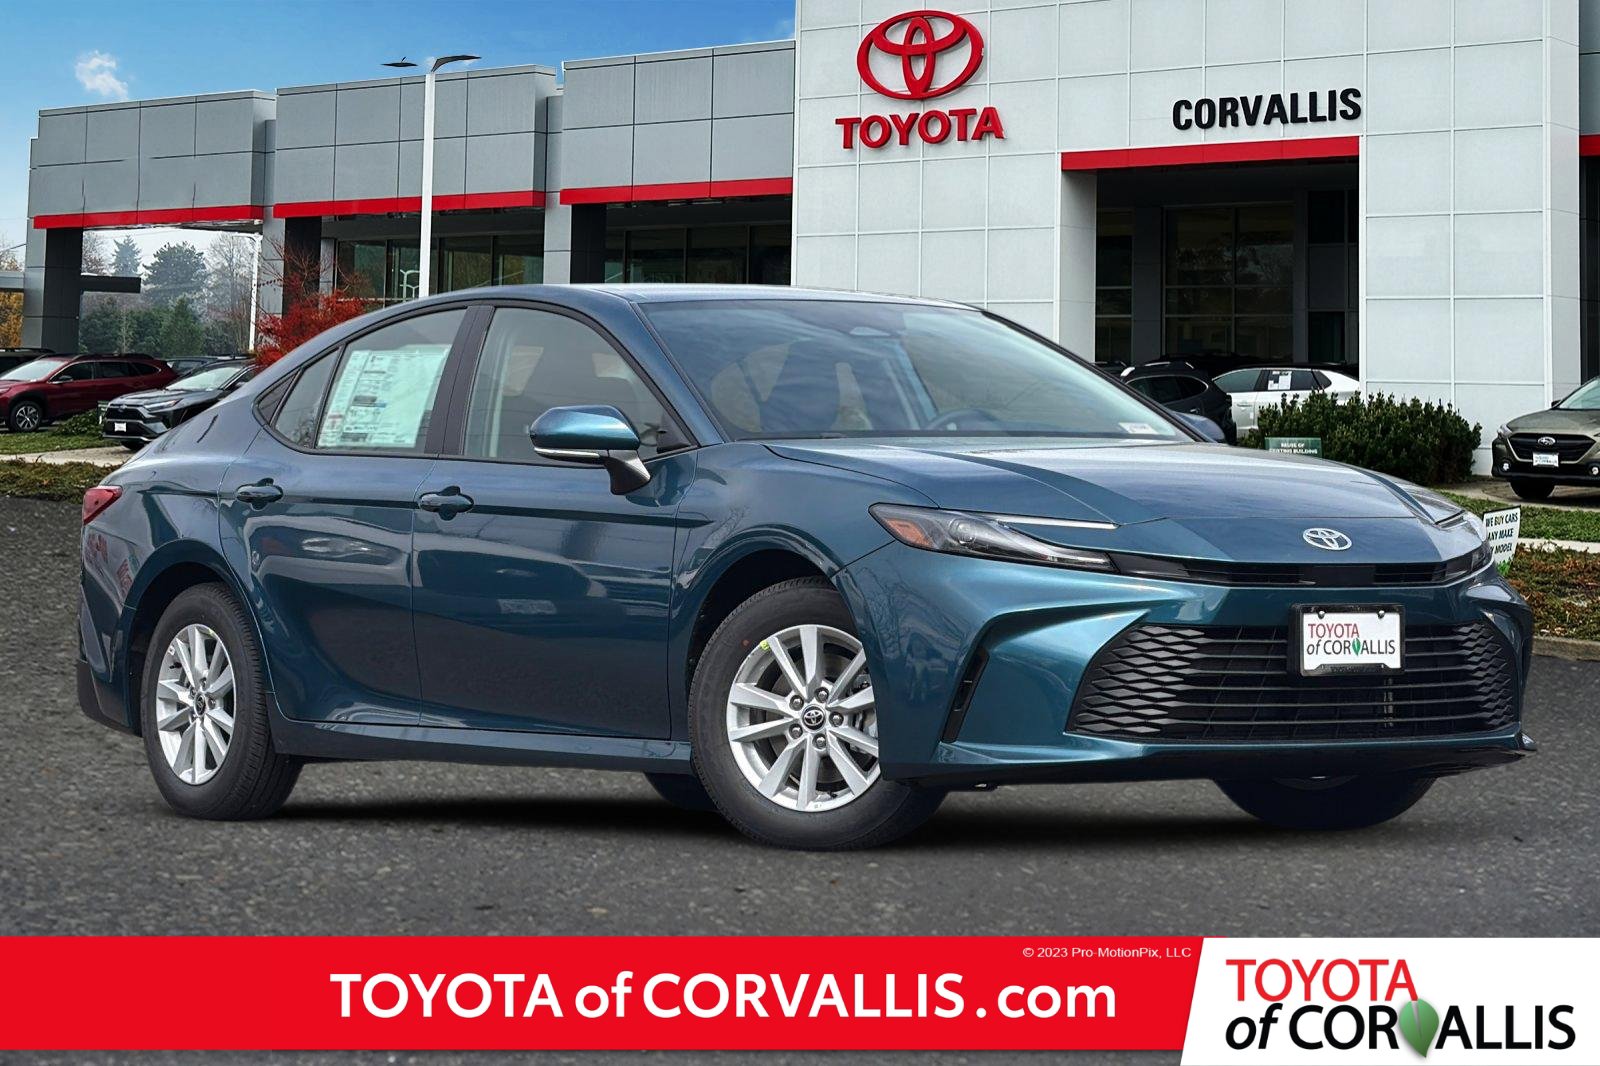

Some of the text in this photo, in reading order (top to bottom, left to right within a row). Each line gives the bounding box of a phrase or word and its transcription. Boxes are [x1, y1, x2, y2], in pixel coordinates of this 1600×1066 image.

[1172, 87, 1362, 131] CORVALLIS
[836, 106, 1005, 149] TOYOTA
[1485, 512, 1519, 527] WE BUY CARS
[1488, 527, 1514, 541] ANY MAKE
[1494, 543, 1513, 554] MODEL
[1307, 622, 1360, 638] TOYOTA
[1306, 638, 1322, 656] of
